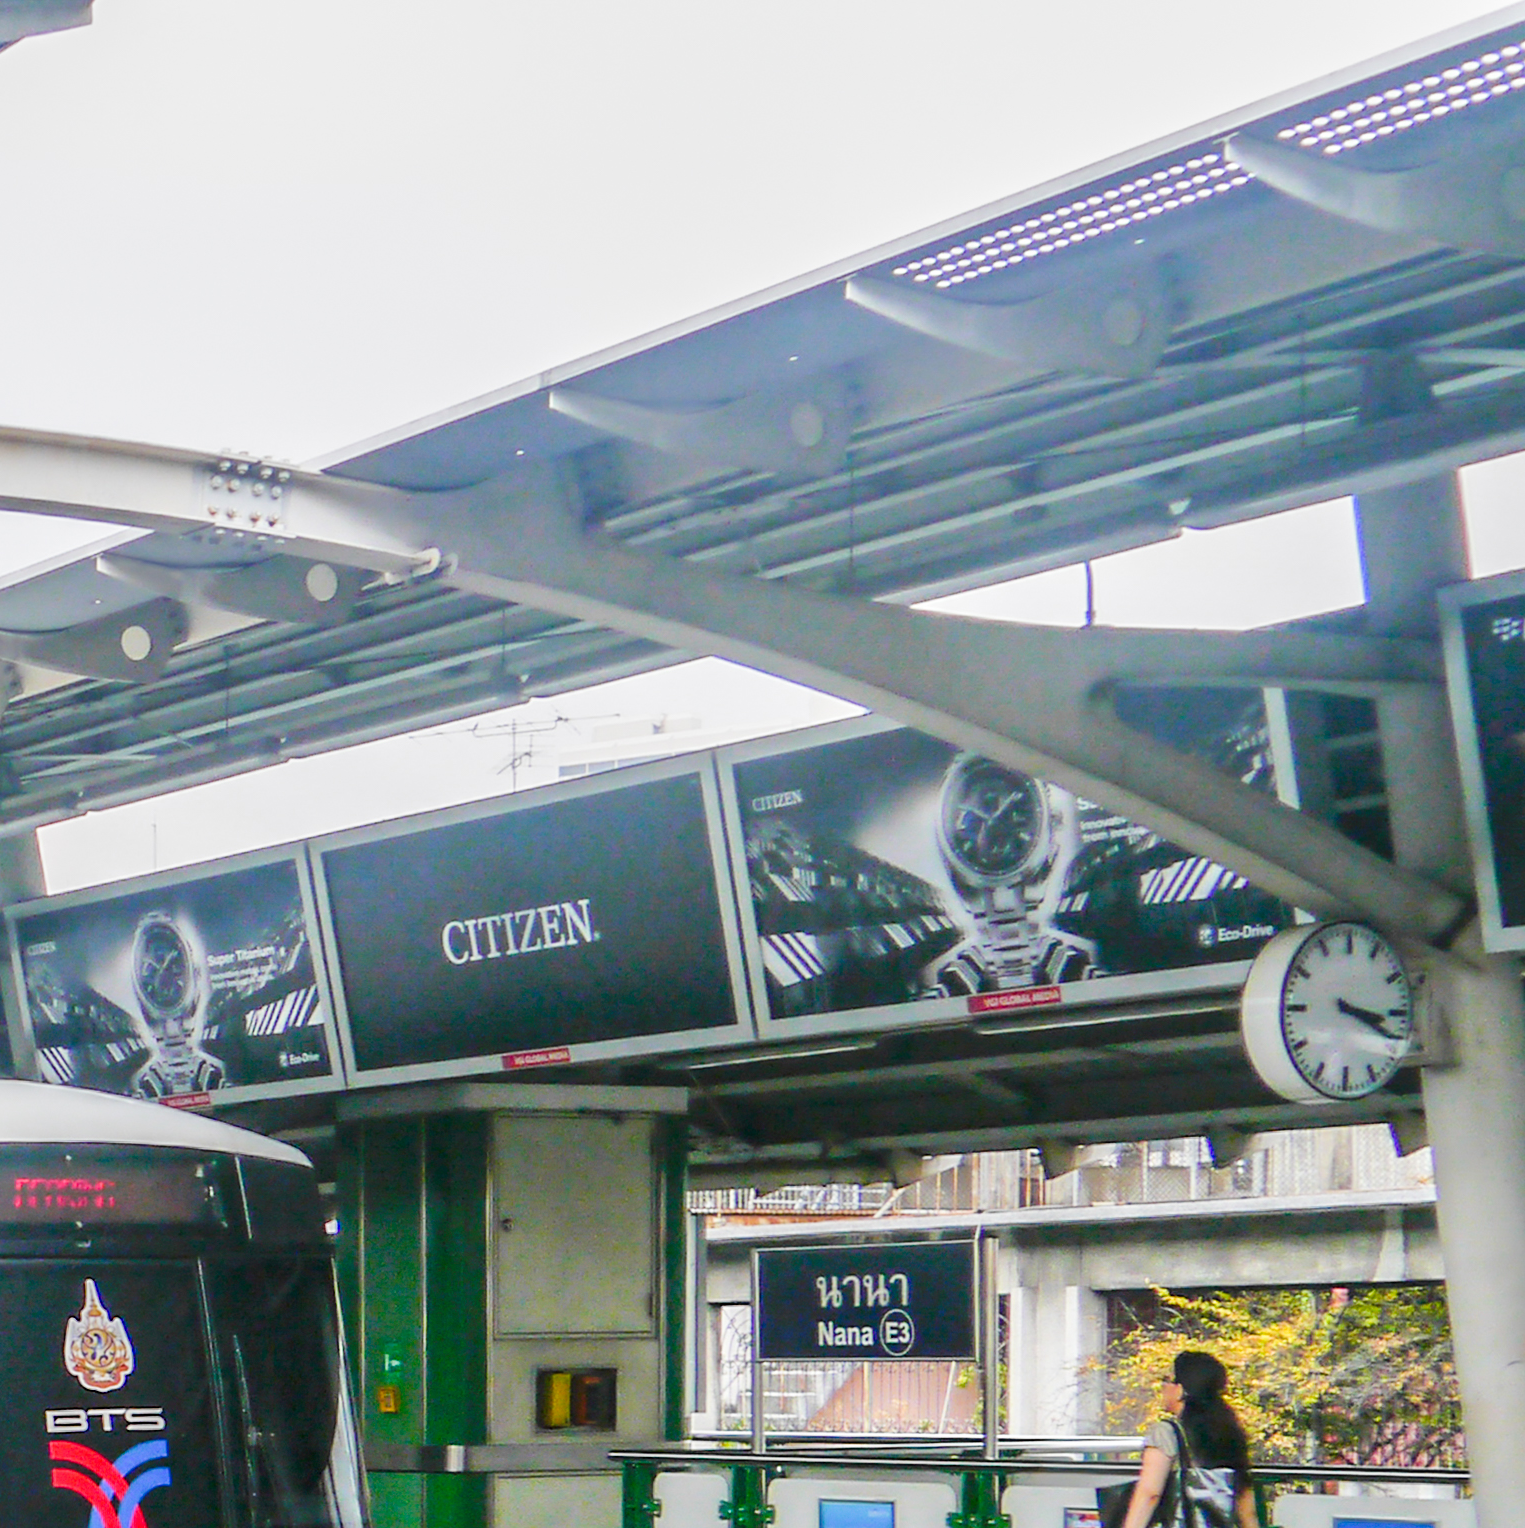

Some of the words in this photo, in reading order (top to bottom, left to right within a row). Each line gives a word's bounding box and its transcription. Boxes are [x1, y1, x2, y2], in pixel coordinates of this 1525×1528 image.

[752, 789, 803, 812] CITIZEN
[441, 898, 595, 966] CITIZEN
[1218, 924, 1274, 942] Eco-Drive
[816, 1273, 909, 1308] นานา
[817, 1321, 875, 1347] Nana
[885, 1321, 911, 1344] E3
[44, 1407, 167, 1434] BTS
